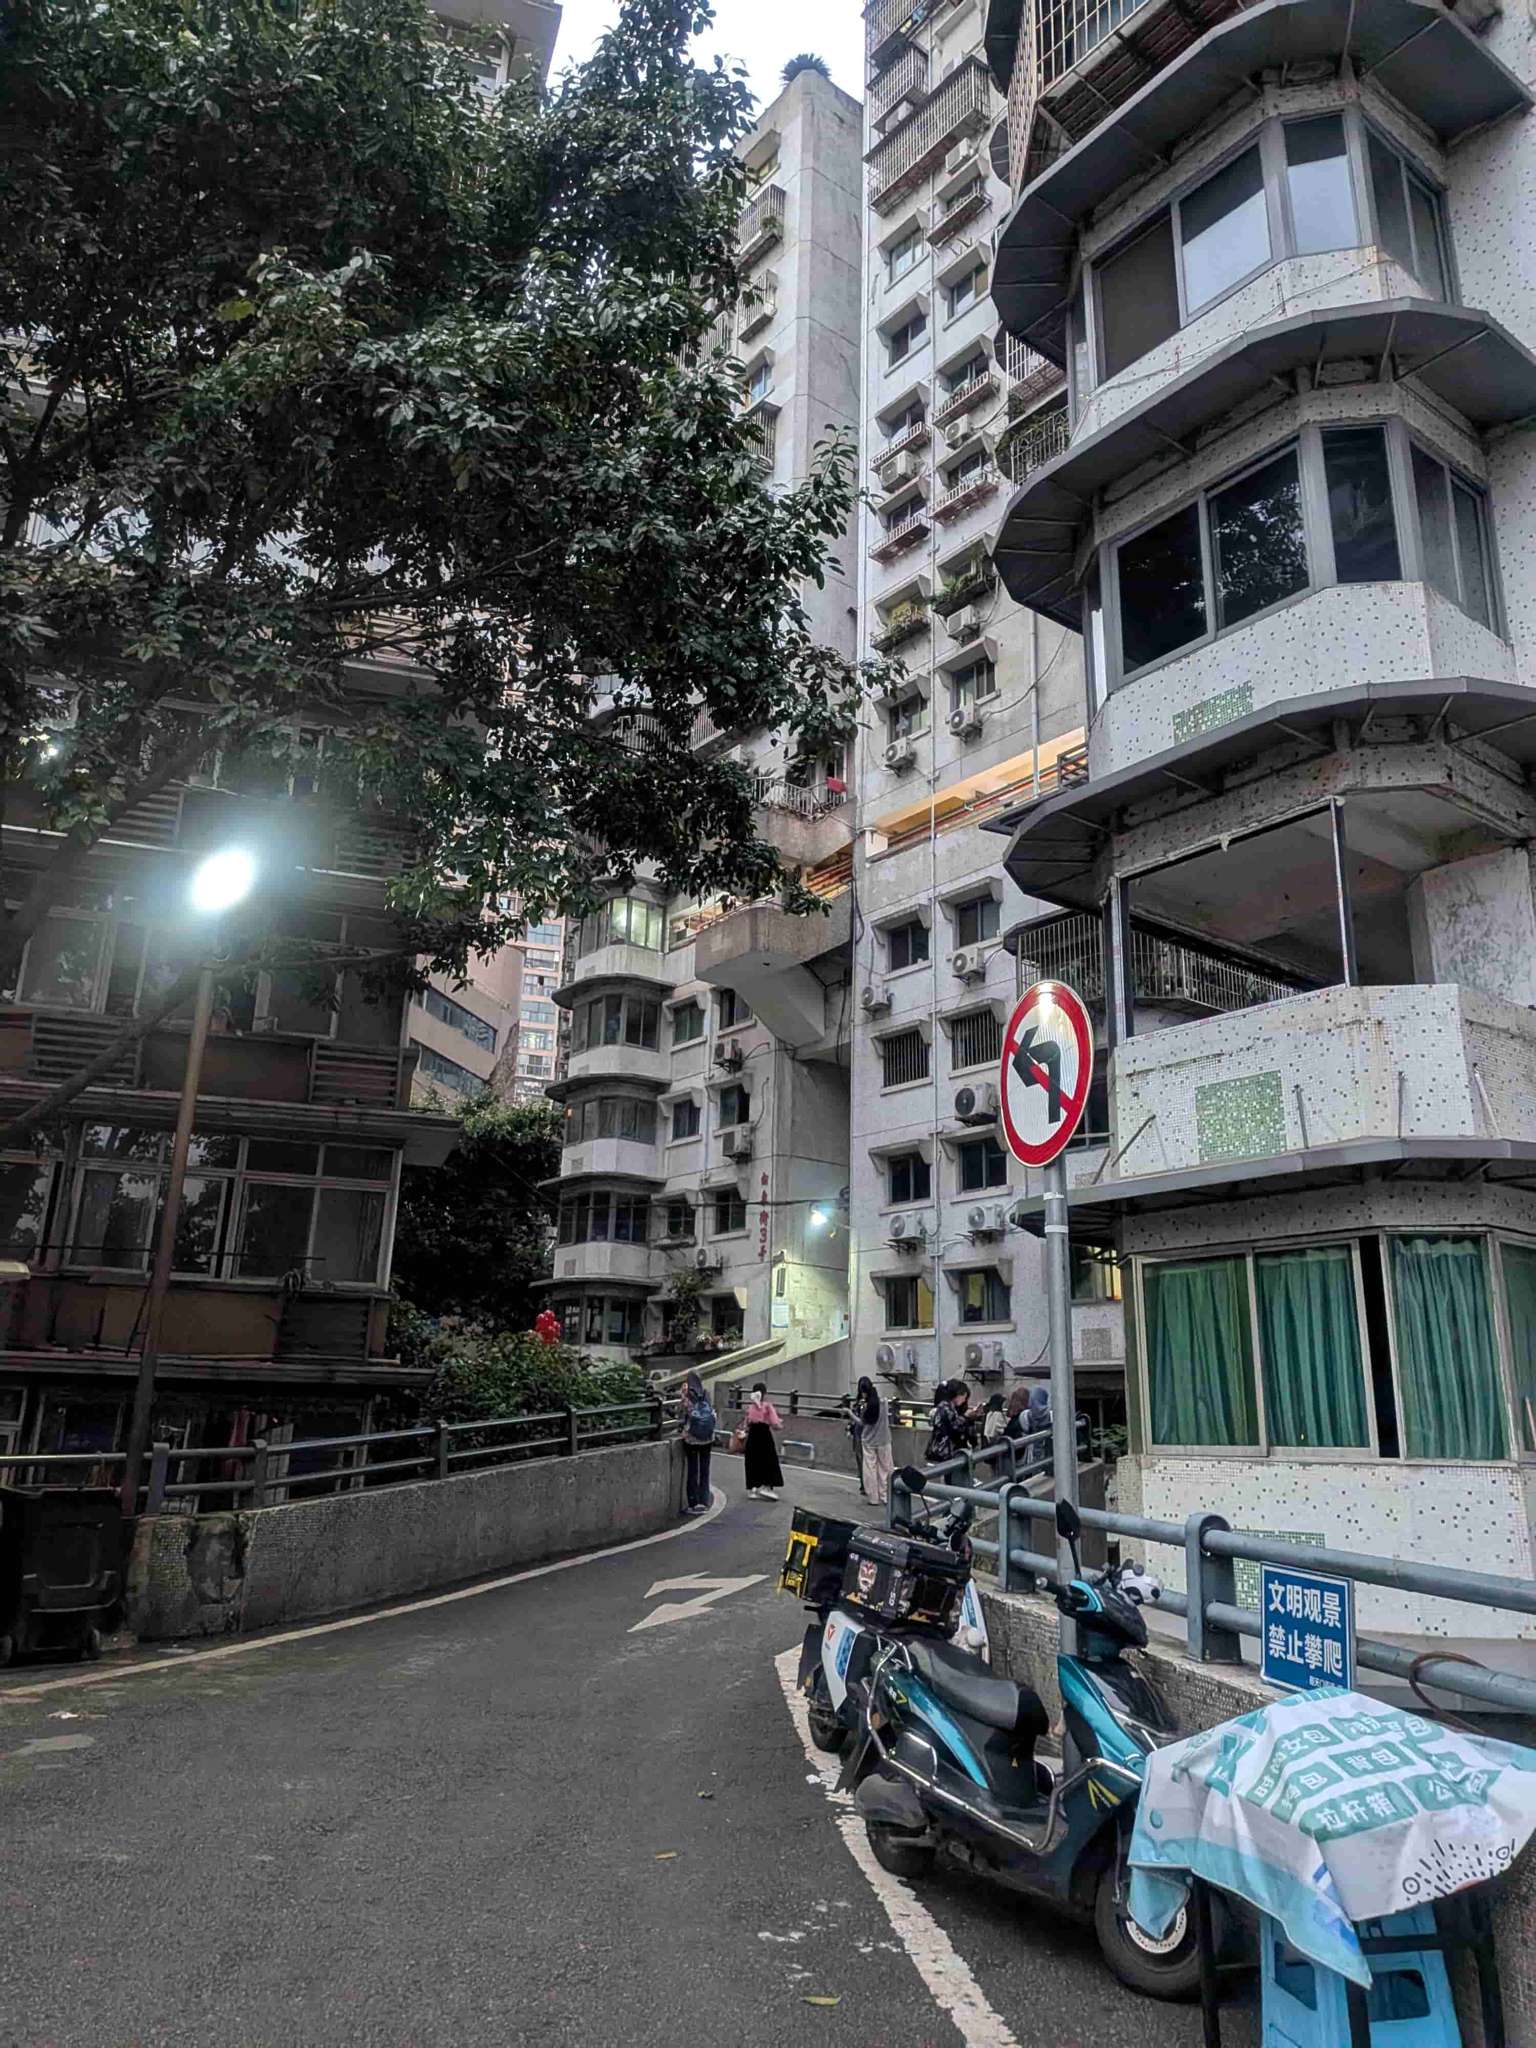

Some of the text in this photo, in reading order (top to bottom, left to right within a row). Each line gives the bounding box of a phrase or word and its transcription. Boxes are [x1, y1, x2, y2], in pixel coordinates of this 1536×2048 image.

[1268, 1579, 1342, 1629] 文明观景
[1268, 1623, 1343, 1676] 禁止攀爬
[1344, 1748, 1401, 1771] 背包
[1428, 1770, 1488, 1802] 公包
[1315, 1791, 1398, 1831] 拉杆箱
